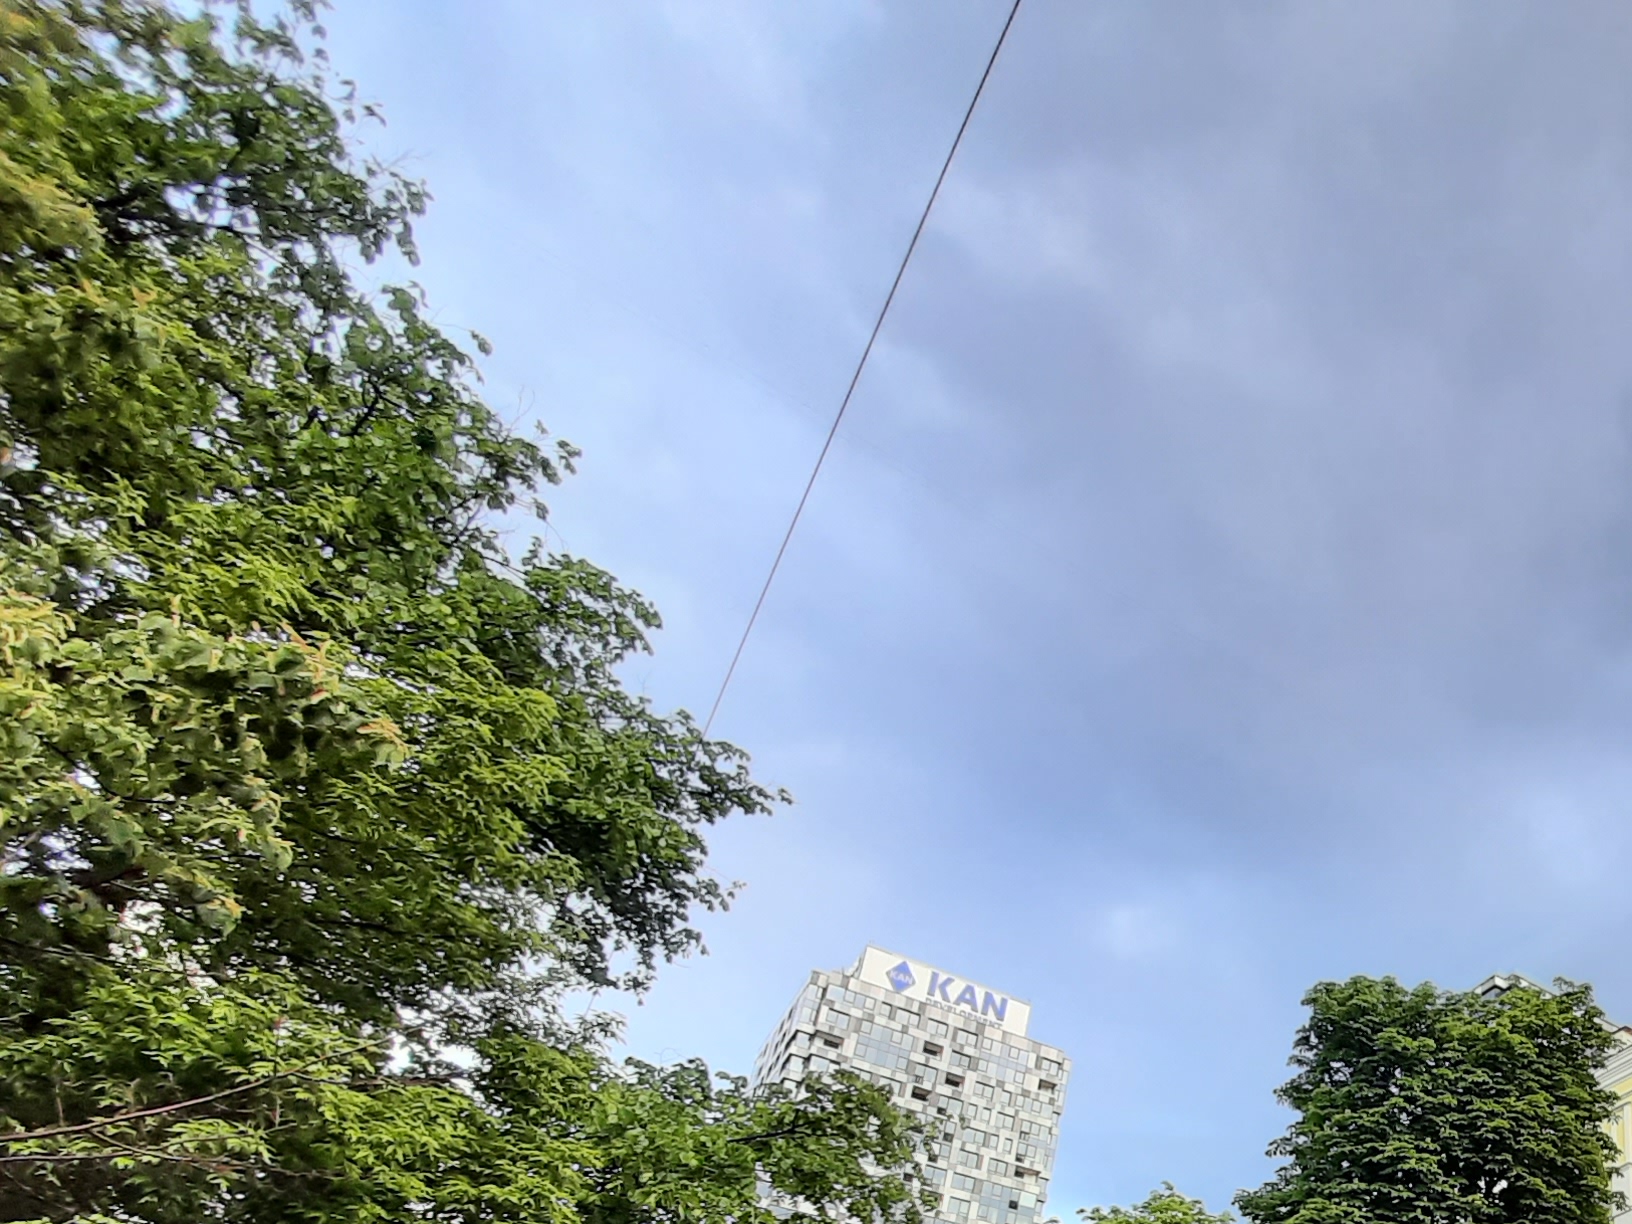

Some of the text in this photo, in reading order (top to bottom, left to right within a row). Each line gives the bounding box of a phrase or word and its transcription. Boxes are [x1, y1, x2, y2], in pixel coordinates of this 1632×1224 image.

[889, 969, 914, 985] KAN
[927, 970, 1009, 1022] KAN
[925, 997, 1003, 1030] DEVELOPMENT
